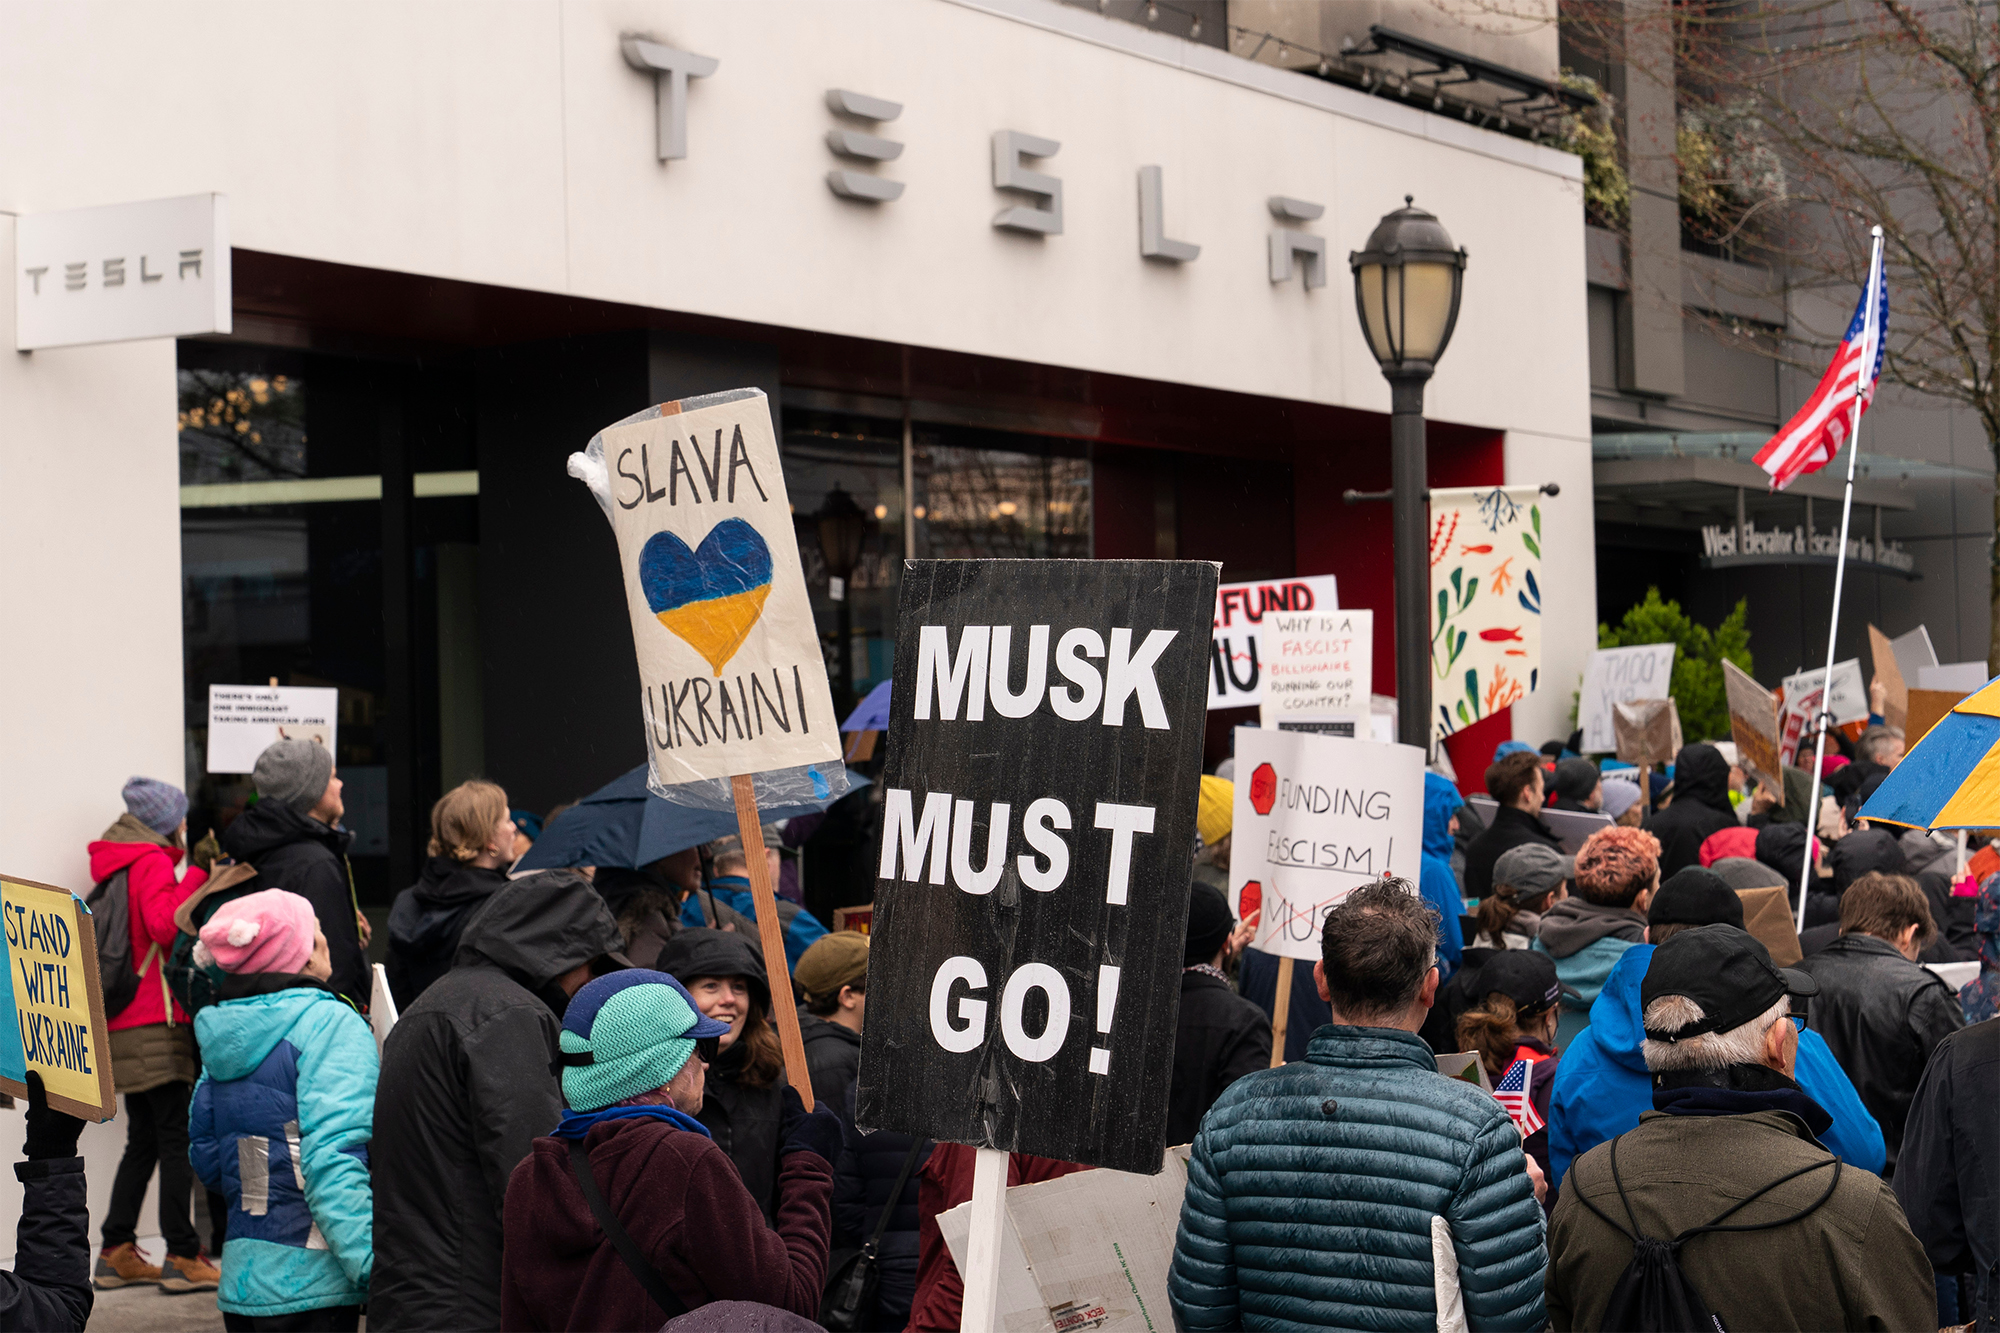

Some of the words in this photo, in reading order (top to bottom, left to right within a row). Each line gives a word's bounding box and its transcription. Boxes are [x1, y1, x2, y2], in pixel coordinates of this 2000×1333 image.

[620, 32, 1327, 290] TESLA
[25, 249, 203, 295] TESLA
[617, 424, 769, 511] SLAVA
[1702, 524, 1737, 557] West
[1213, 582, 1315, 628] FUND
[1275, 616, 1311, 633] WHY
[1320, 617, 1332, 633] IS
[1340, 617, 1353, 634] A
[1271, 661, 1351, 676] BILLIONAIRE
[1282, 639, 1352, 657] FASCIST
[914, 624, 1179, 730] MUSK
[1271, 679, 1320, 693] RUNNING
[1327, 679, 1353, 691] OUR
[214, 716, 248, 724] TAKING
[251, 716, 299, 724] AMERICAN
[302, 717, 326, 725] JOBS
[647, 665, 809, 751] UKRAINI
[1283, 694, 1351, 710] COUNTRY?
[1280, 778, 1391, 821] FUNDING
[879, 788, 1156, 906] MUST
[4, 900, 71, 959] STAND
[1263, 897, 1338, 943] MU
[19, 957, 70, 1009] WITH
[928, 955, 1121, 1076] GO!
[19, 1008, 92, 1074] UKRAINE
